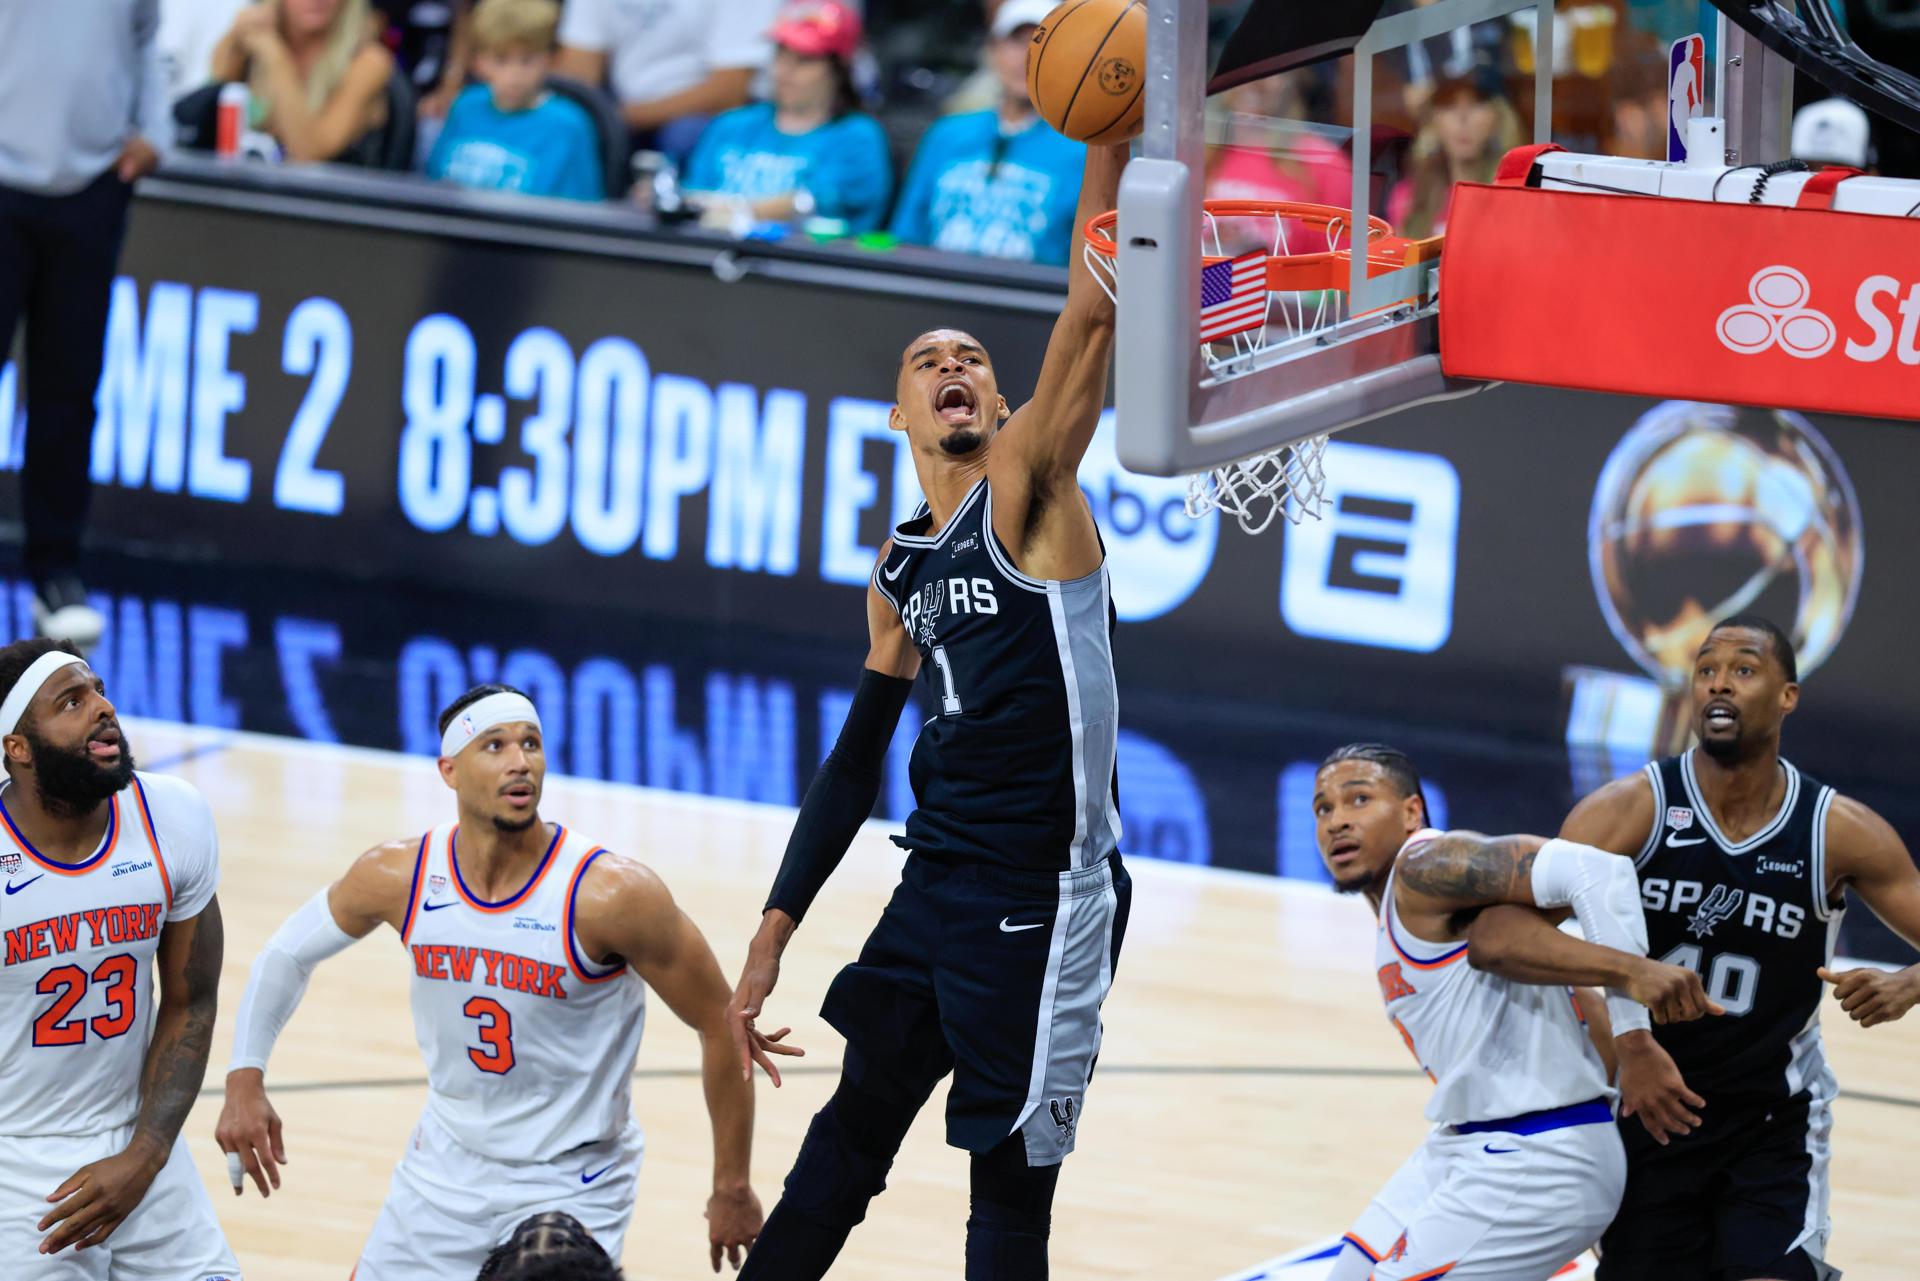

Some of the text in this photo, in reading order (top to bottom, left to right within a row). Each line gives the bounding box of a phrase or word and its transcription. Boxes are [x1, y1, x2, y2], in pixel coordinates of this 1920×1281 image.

[273, 295, 353, 516] 2
[397, 312, 808, 577] 8:30PM
[1086, 475, 1197, 543] bc
[954, 538, 975, 553] LEDGER
[902, 577, 999, 648] SPURS
[931, 644, 964, 716] 1
[1762, 860, 1799, 873] LEDGER
[4, 903, 163, 968] NEW YORK
[1642, 877, 1805, 939] SPURS
[32, 952, 138, 1048] 23
[411, 944, 568, 999] NEW YORK
[462, 995, 516, 1076] 3
